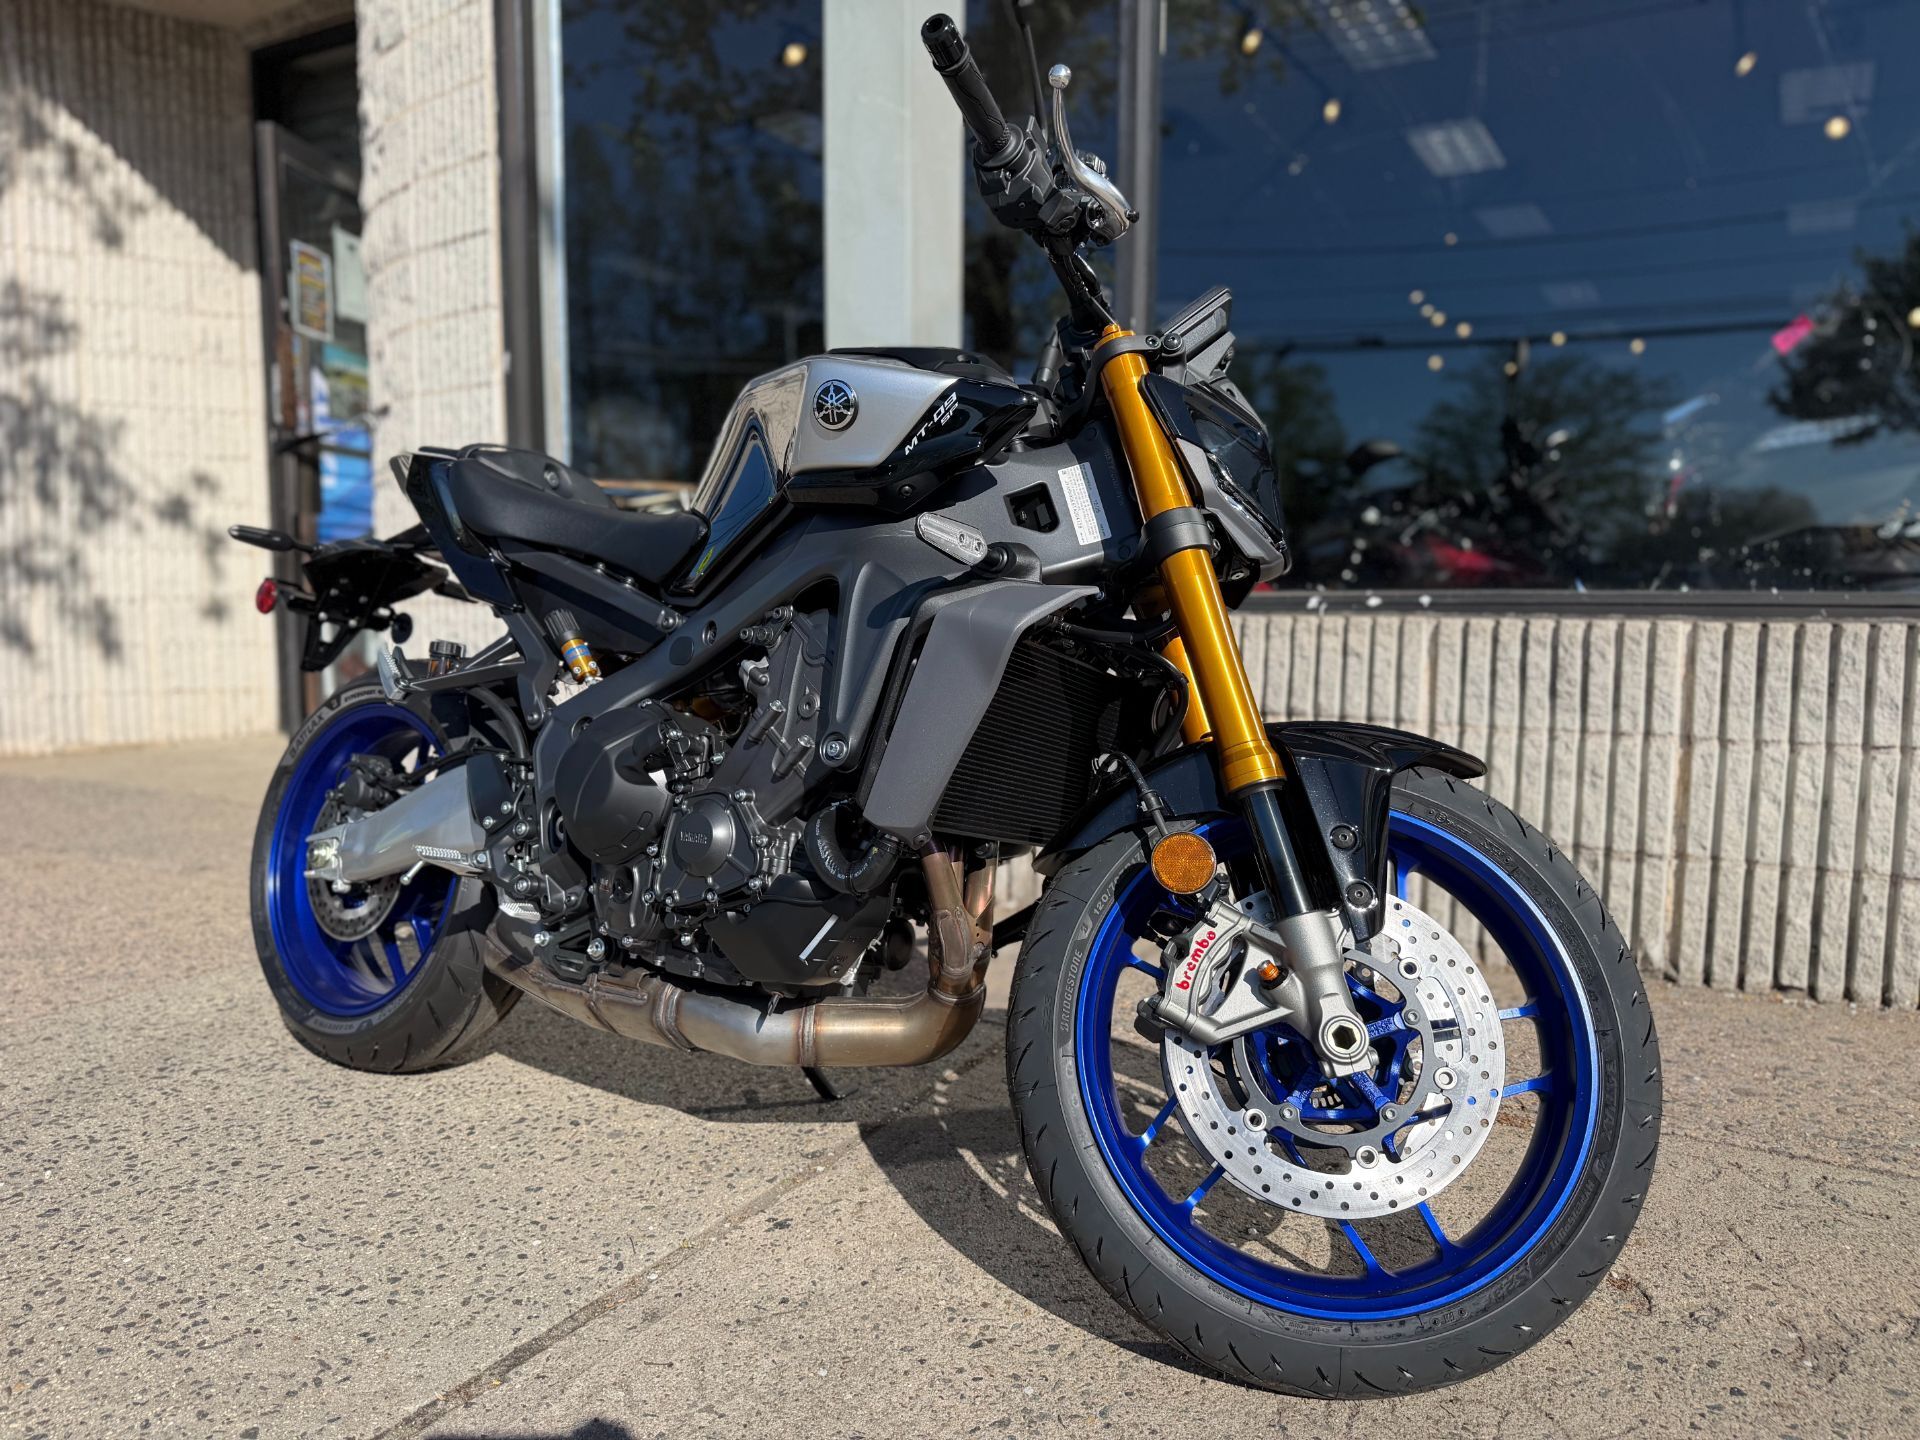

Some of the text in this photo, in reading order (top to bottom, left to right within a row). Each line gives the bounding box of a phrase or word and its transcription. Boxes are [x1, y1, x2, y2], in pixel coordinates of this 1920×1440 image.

[904, 391, 957, 456] MT-09
[940, 401, 959, 426] SP
[680, 831, 708, 845] YAMAHA
[1060, 949, 1083, 1033] BRIDGESTONE
[1175, 930, 1217, 991] brembo
